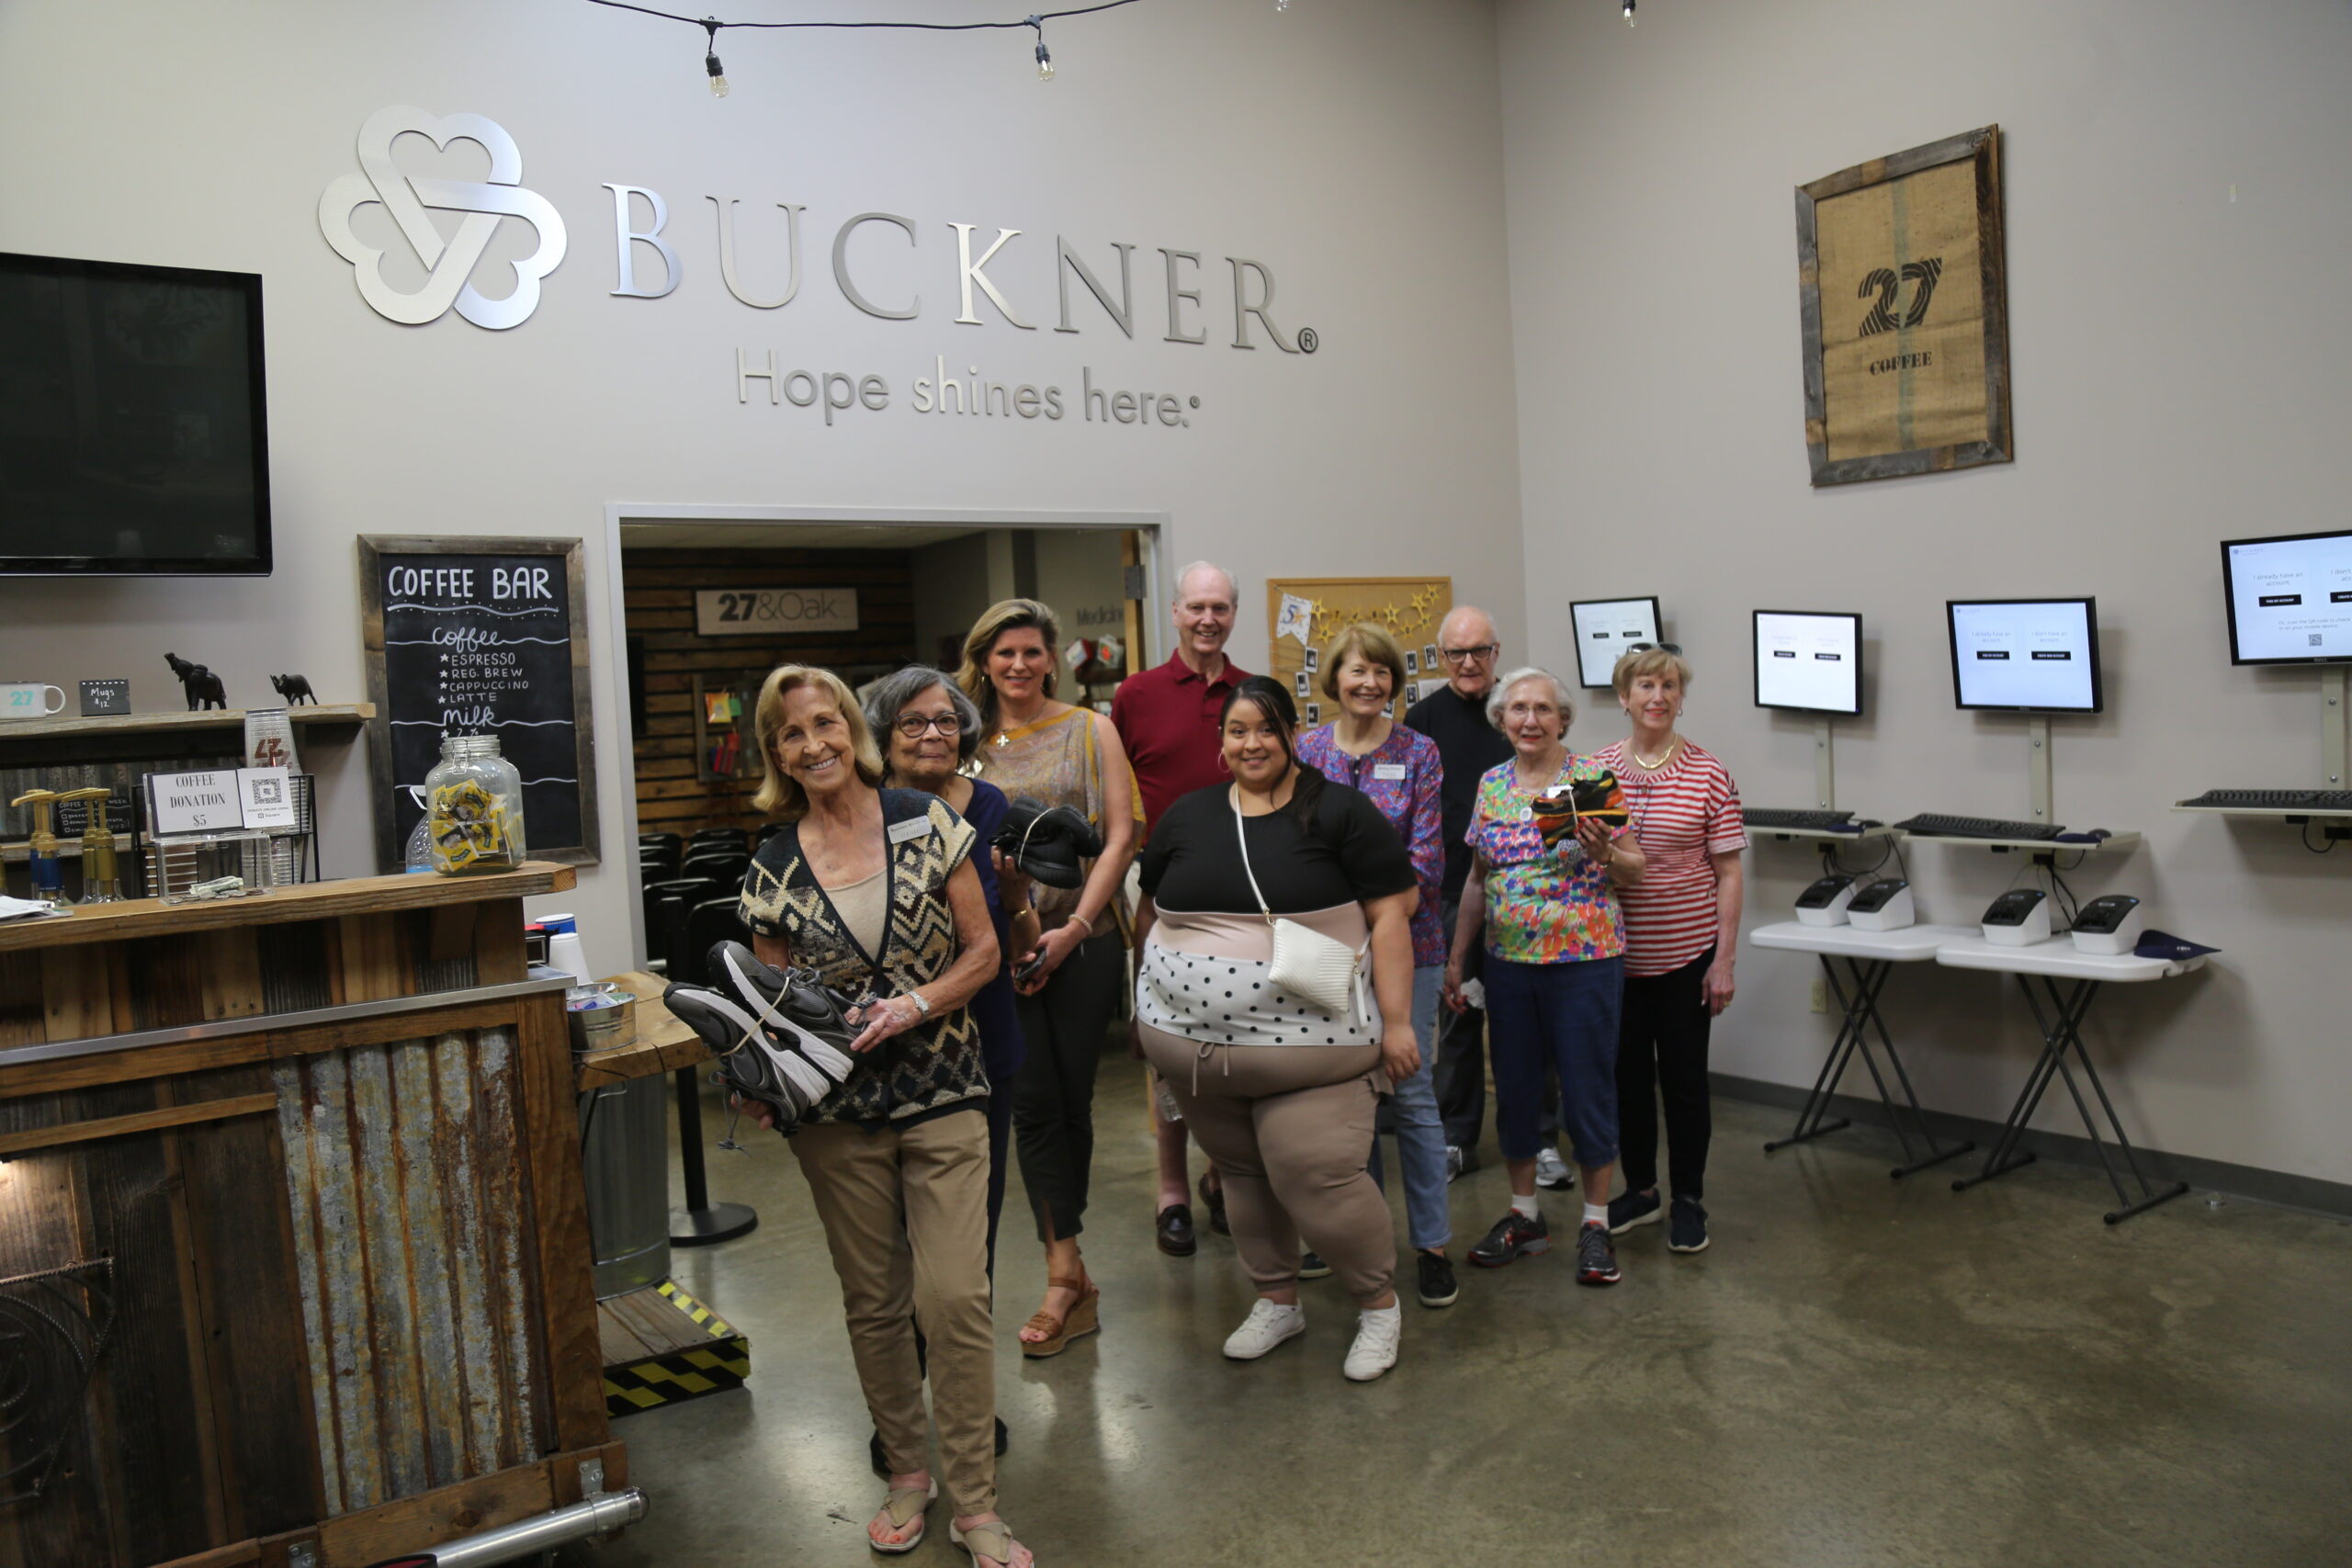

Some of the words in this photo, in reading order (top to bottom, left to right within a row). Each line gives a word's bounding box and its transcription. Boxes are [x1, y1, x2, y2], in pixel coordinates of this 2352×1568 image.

[1858, 257, 1942, 338] 27
[1870, 352, 1932, 376] COFFEE
[736, 346, 889, 426] Hope
[912, 355, 1064, 421] shines
[389, 566, 474, 598] COFFEE
[492, 567, 553, 600] BAR
[451, 653, 516, 667] ESPRESSO
[451, 669, 481, 679] REG.
[485, 668, 523, 678] BREW
[449, 681, 529, 692] CAPPUCCINO
[10, 691, 34, 706] 27
[90, 687, 115, 701] Mugs
[450, 693, 498, 703] LATTE
[175, 773, 216, 787] COFFEE
[170, 793, 226, 808] DONATION
[193, 815, 207, 827] $5
